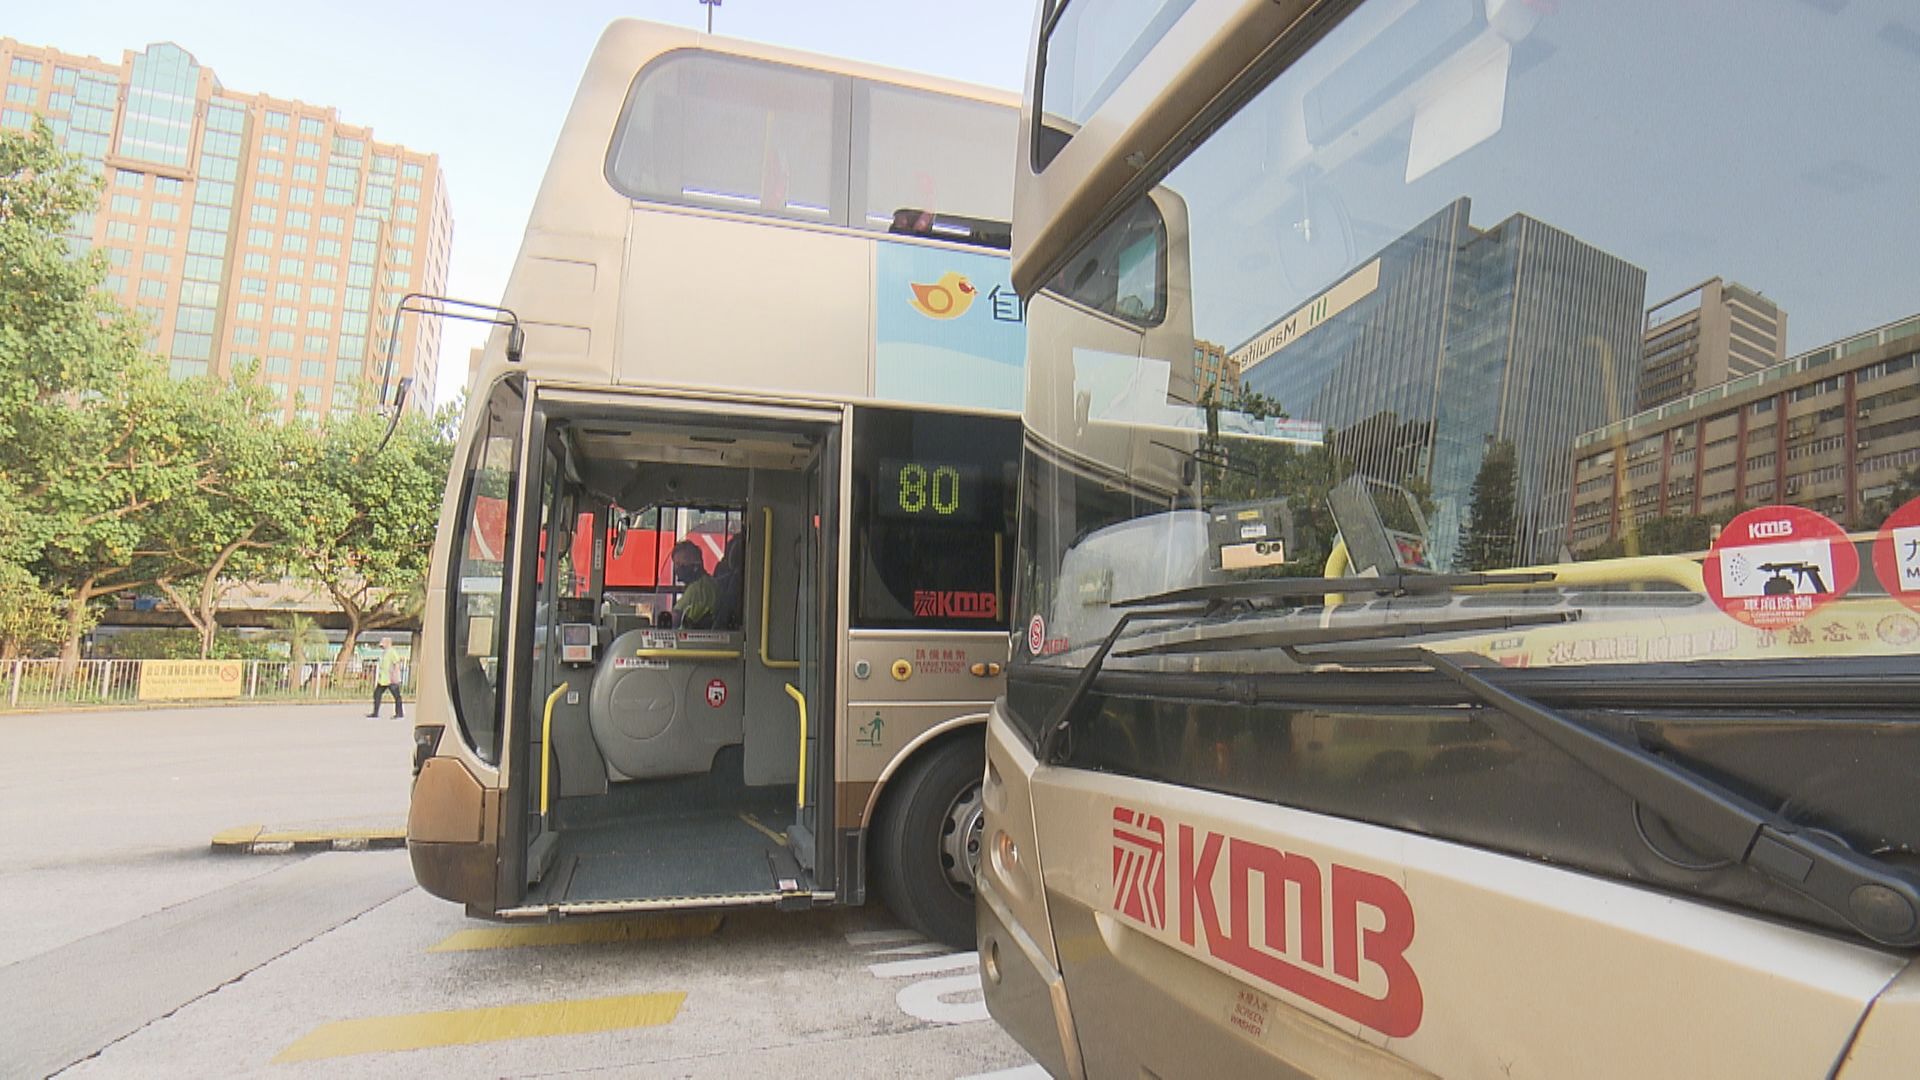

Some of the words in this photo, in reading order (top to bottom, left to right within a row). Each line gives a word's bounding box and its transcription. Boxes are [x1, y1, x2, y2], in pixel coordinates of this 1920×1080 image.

[899, 463, 959, 515] 80
[1748, 519, 1793, 539] KMB
[937, 591, 997, 618] KMB
[1178, 824, 1424, 1038] KMB
[1230, 1015, 1262, 1037] WASHER
[1234, 1003, 1265, 1026] SCREEN
